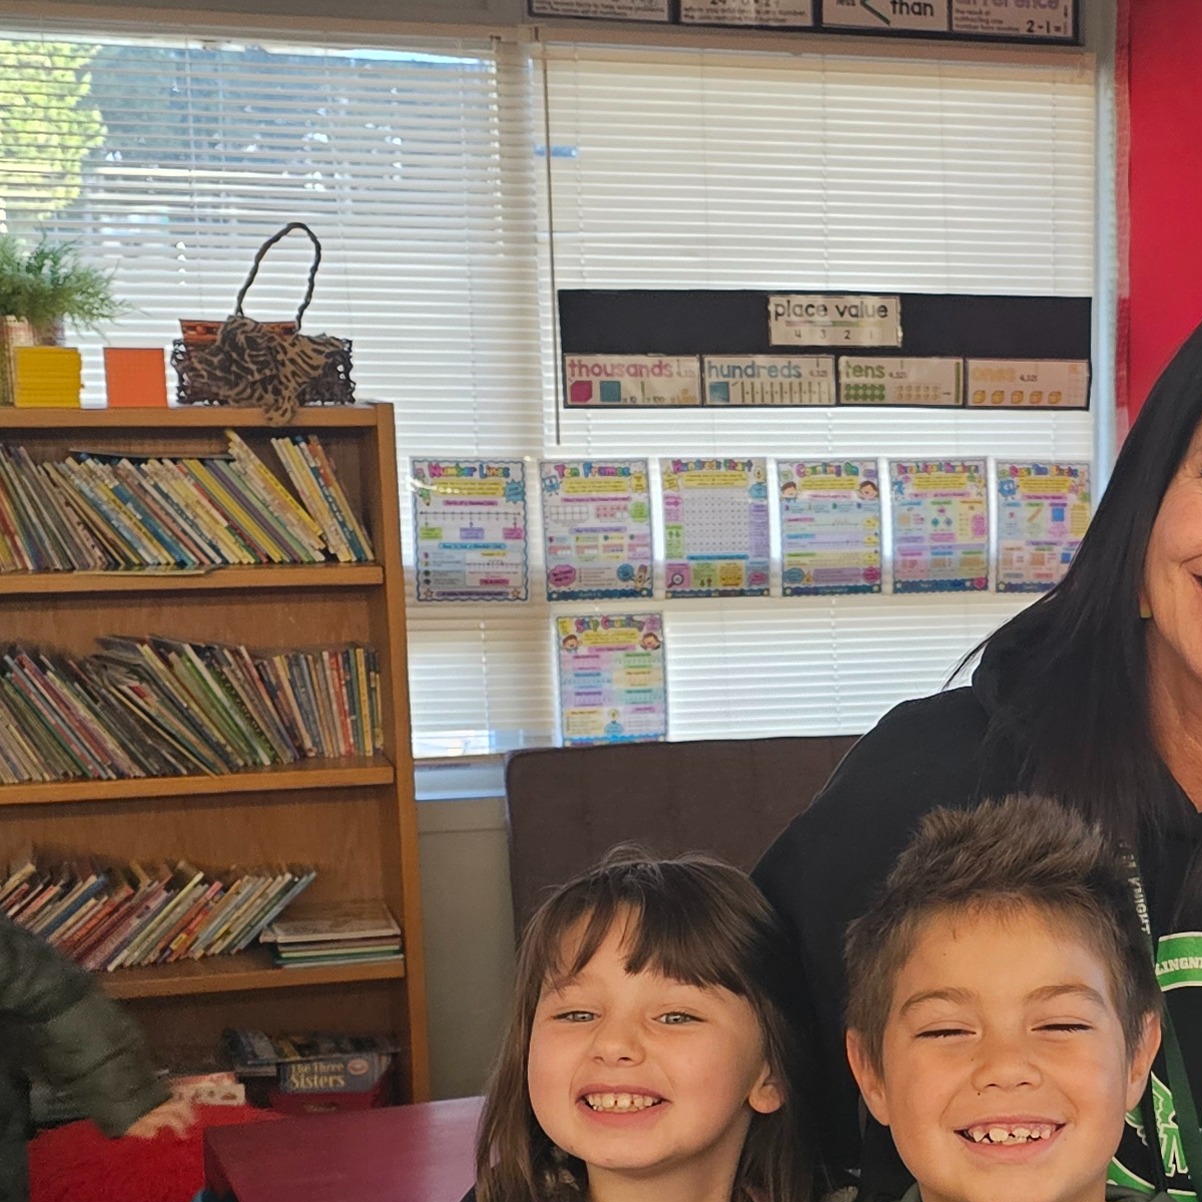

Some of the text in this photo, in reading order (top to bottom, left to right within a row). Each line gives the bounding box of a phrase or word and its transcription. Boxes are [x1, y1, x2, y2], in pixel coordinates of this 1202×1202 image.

[774, 300, 889, 322] place value
[568, 359, 673, 378] thousands
[708, 361, 802, 379] hundreds
[314, 1062, 344, 1073] Three
[290, 1073, 345, 1089] Sisters
